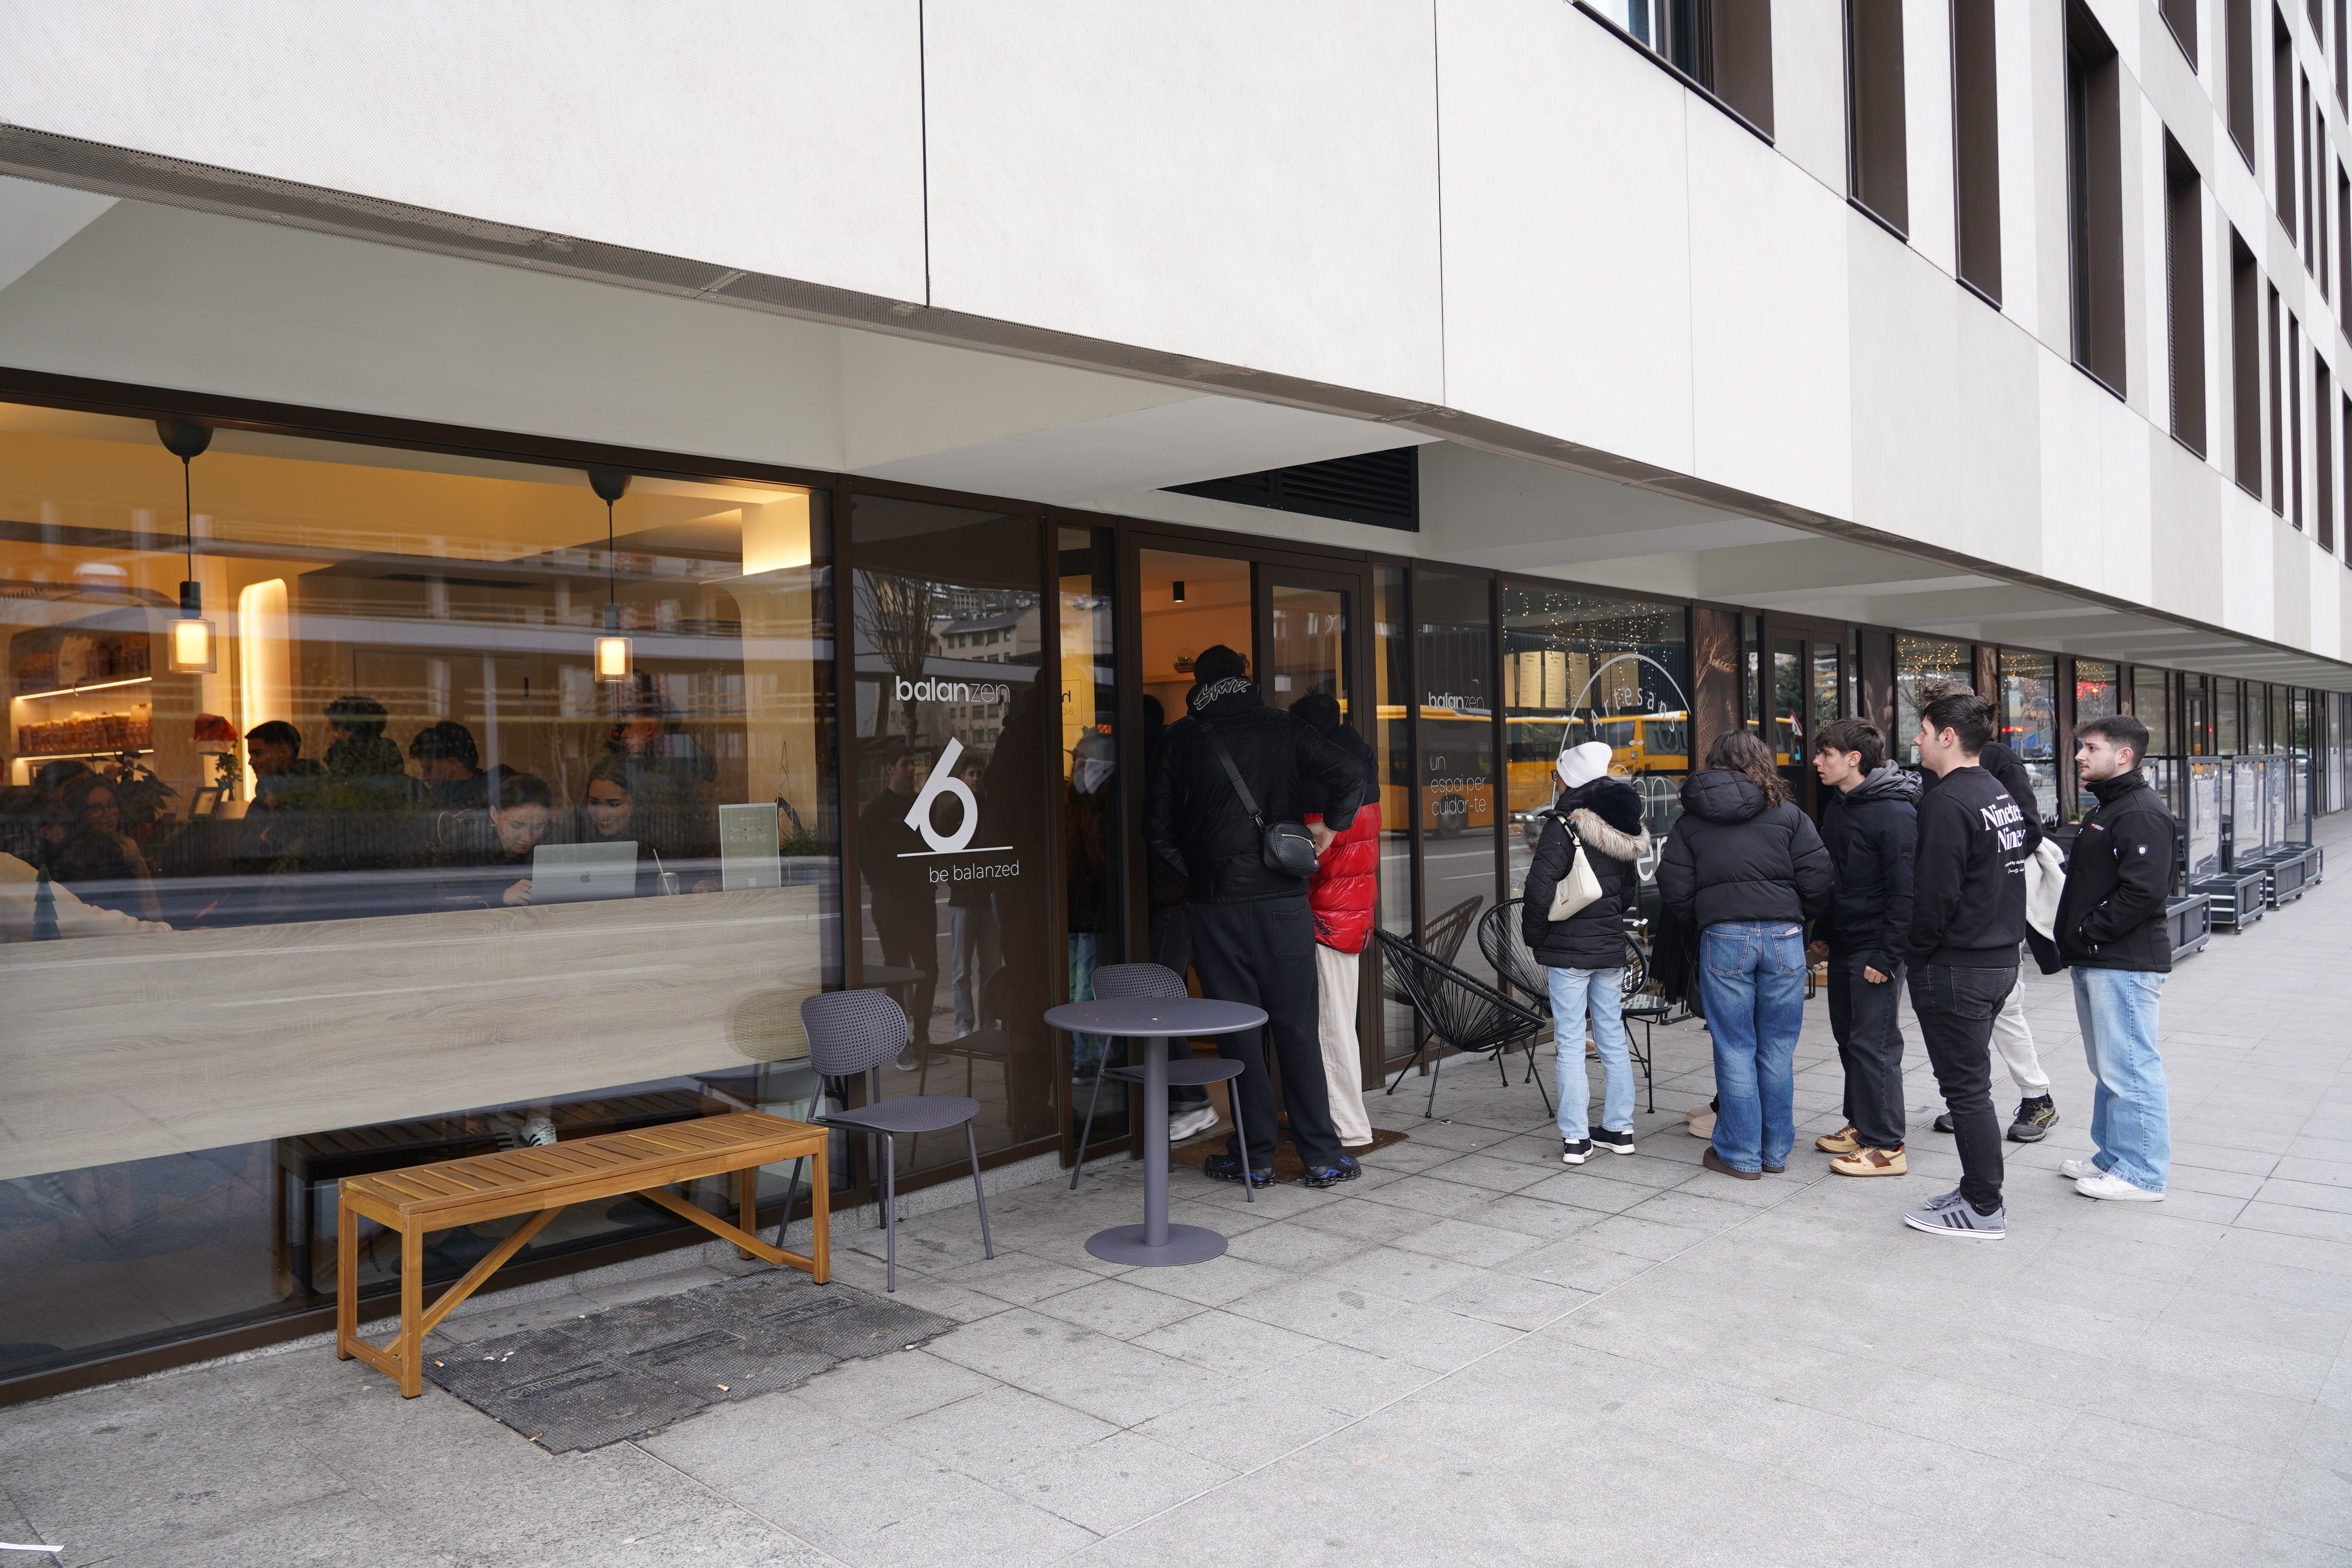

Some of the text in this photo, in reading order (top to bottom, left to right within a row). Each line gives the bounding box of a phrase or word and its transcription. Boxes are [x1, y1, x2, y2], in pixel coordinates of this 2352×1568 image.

[896, 676, 1010, 703] balanzen
[1428, 692, 1484, 709] balanzen
[1591, 687, 1677, 736] Artesans
[1430, 755, 1446, 771] un
[1431, 774, 1486, 797] espai per
[1431, 795, 1486, 816] cuidar-te
[929, 860, 1019, 883] be balanzed
